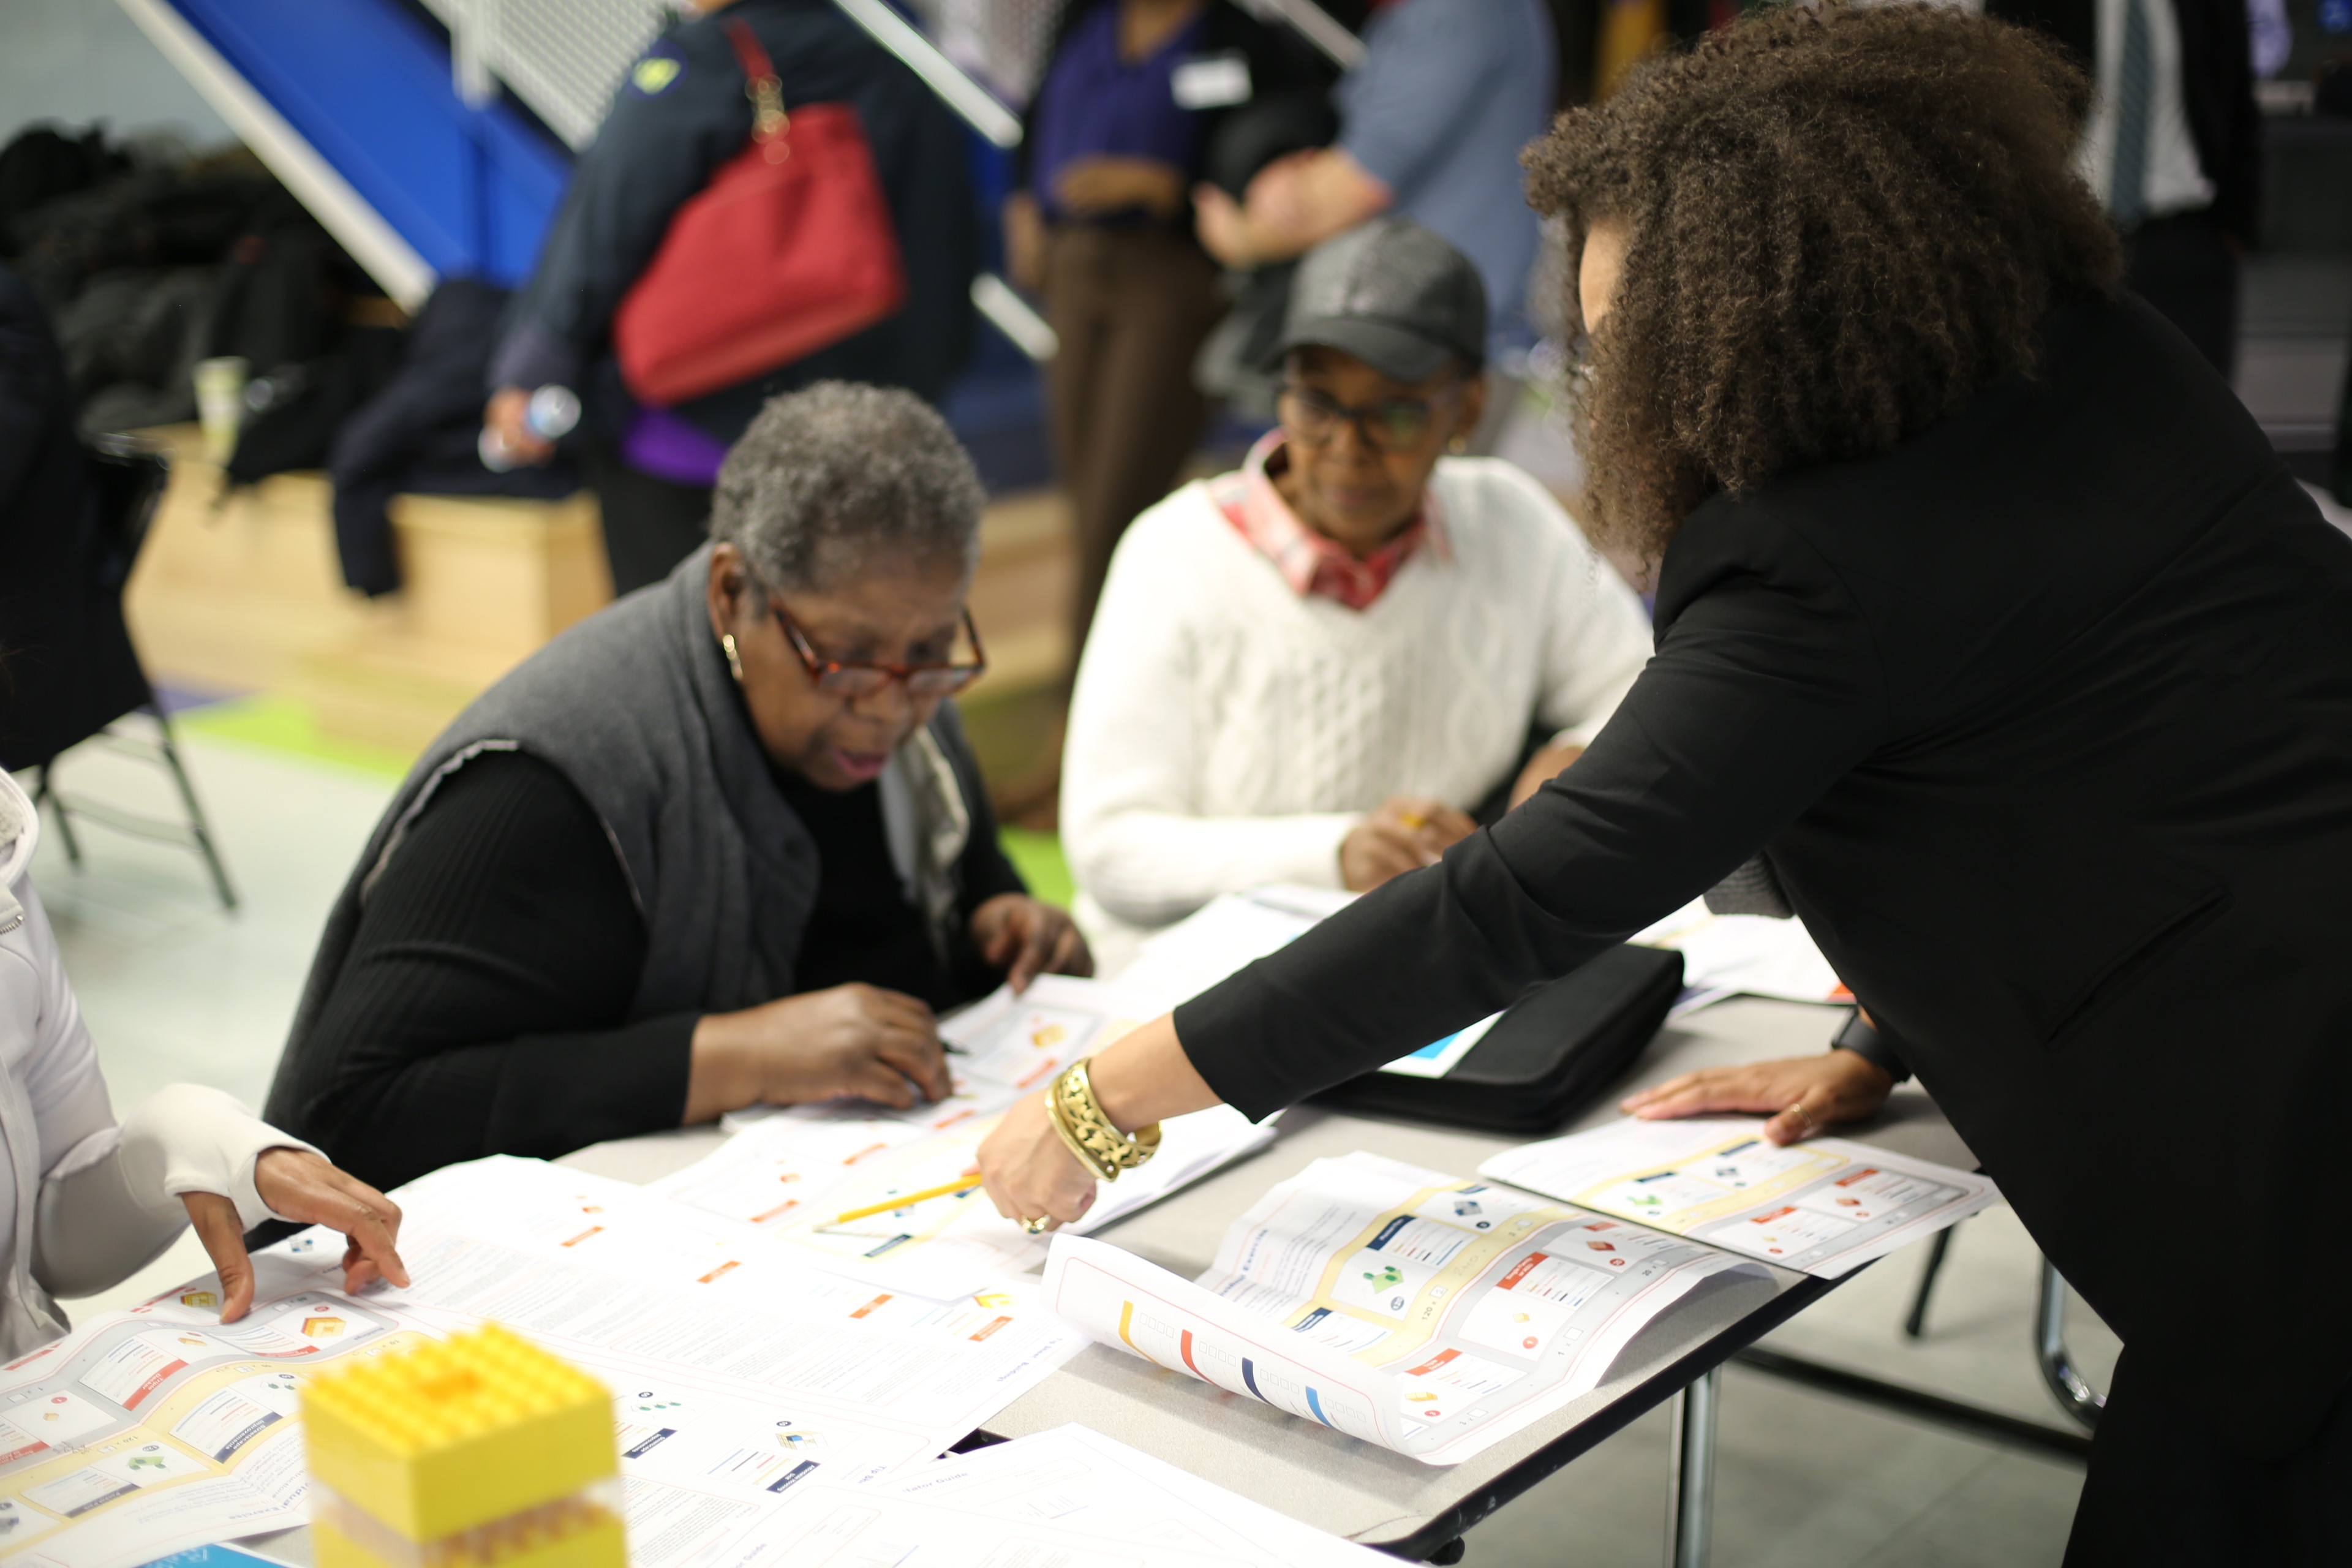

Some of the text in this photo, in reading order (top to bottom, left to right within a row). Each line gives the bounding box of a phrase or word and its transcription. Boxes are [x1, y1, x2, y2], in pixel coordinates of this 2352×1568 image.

[1422, 1306, 1433, 1320] 120
[142, 1373, 161, 1390] Decker
[997, 1362, 1029, 1382] Buildings
[148, 1378, 163, 1390] Triple
[233, 1425, 266, 1450] Streetscape
[272, 1466, 309, 1498] nstructions
[902, 1473, 968, 1493] itator Guide
[228, 1482, 312, 1520] vidual Exercise
